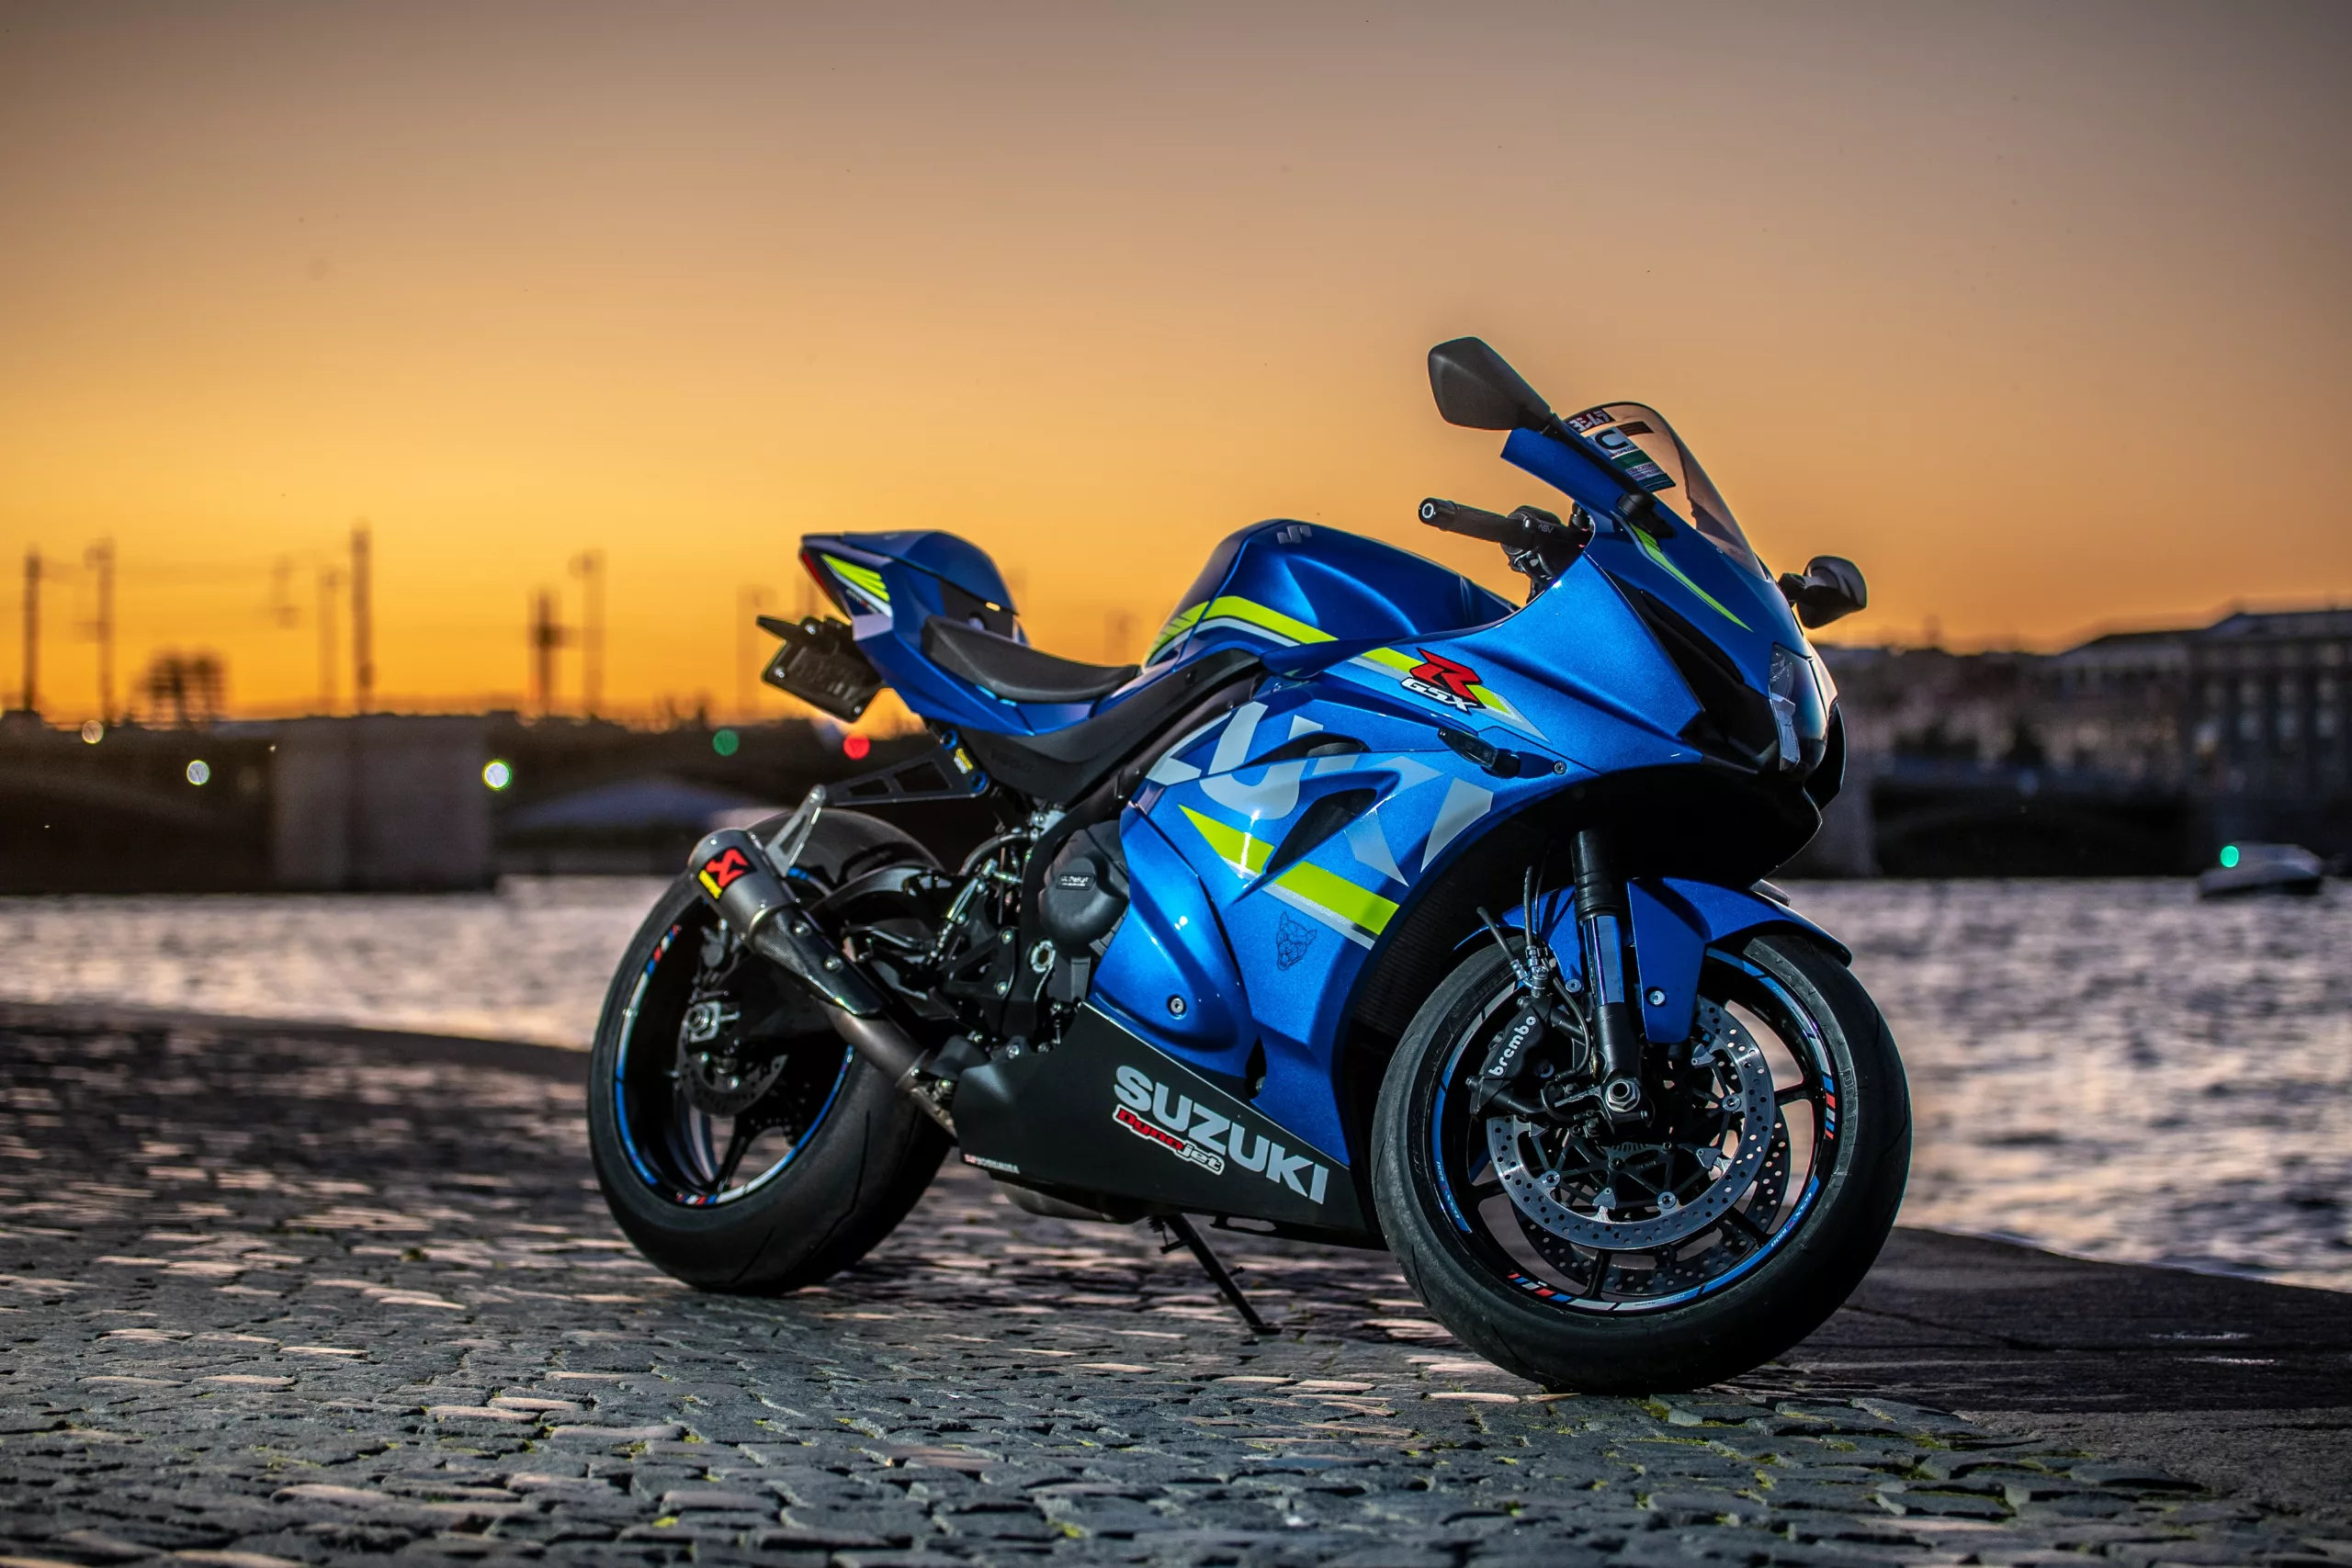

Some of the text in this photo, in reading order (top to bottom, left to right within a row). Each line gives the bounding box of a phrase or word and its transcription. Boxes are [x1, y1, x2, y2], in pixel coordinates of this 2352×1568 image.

[1401, 678, 1478, 712] GSX
[1488, 1016, 1537, 1077] brembo
[1114, 1066, 1329, 1205] SUZUKI
[1770, 1228, 1787, 1247] 1000
